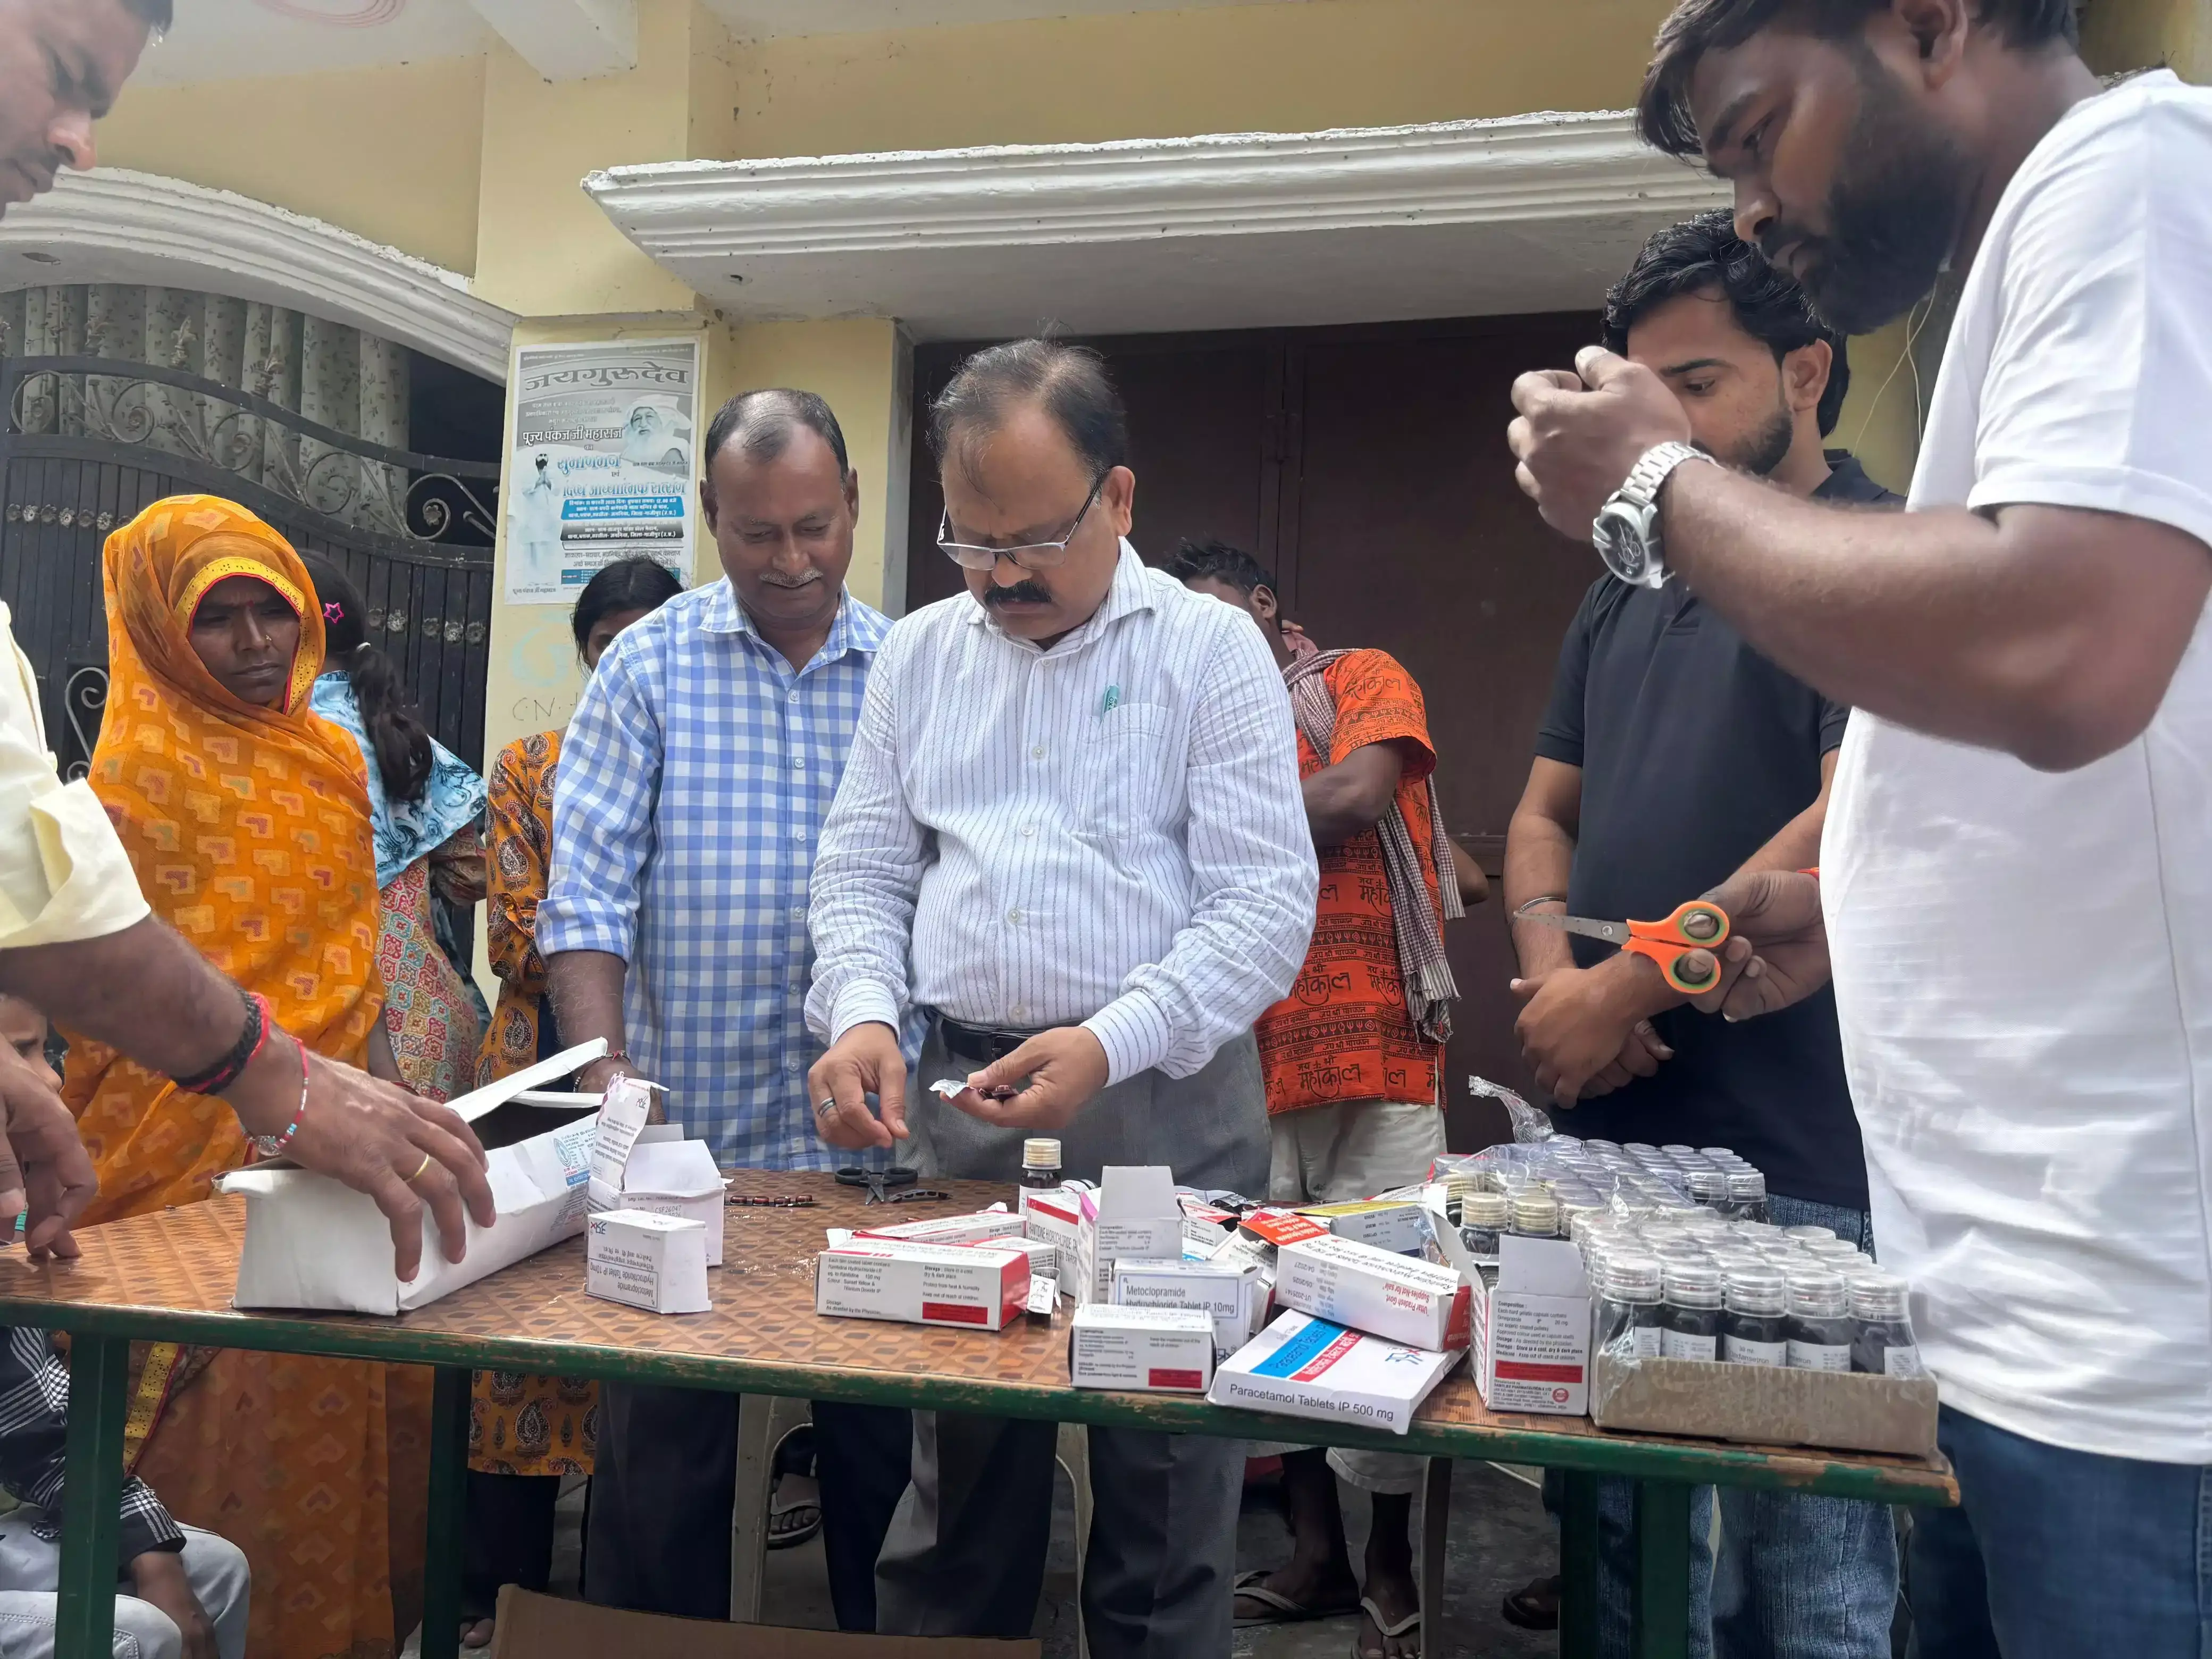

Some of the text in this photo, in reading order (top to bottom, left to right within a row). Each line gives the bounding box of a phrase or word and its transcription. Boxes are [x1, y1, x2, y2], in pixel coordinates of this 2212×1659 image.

[523, 425, 623, 445] पूज्य पंकज जी महाराज
[1029, 1222, 1045, 1239] RANITIDINE
[1045, 1227, 1071, 1250] HYDROCHLORIDE
[590, 1262, 654, 1286] Hydrochloride Tablet IP 10mg
[1294, 1261, 1315, 1273] 04/2027
[617, 1281, 653, 1297] Metoclopramide
[1126, 1285, 1186, 1298] Metoclopramide
[1401, 1287, 1430, 1304] Supplies-Not
[1386, 1294, 1397, 1305] Govt.
[1397, 1298, 1416, 1312] Pradesh
[1203, 1302, 1210, 1310] IP
[1214, 1302, 1235, 1314] 10mg
[1229, 1384, 1394, 1422] Paracetamol Tablets IP 500 mg
